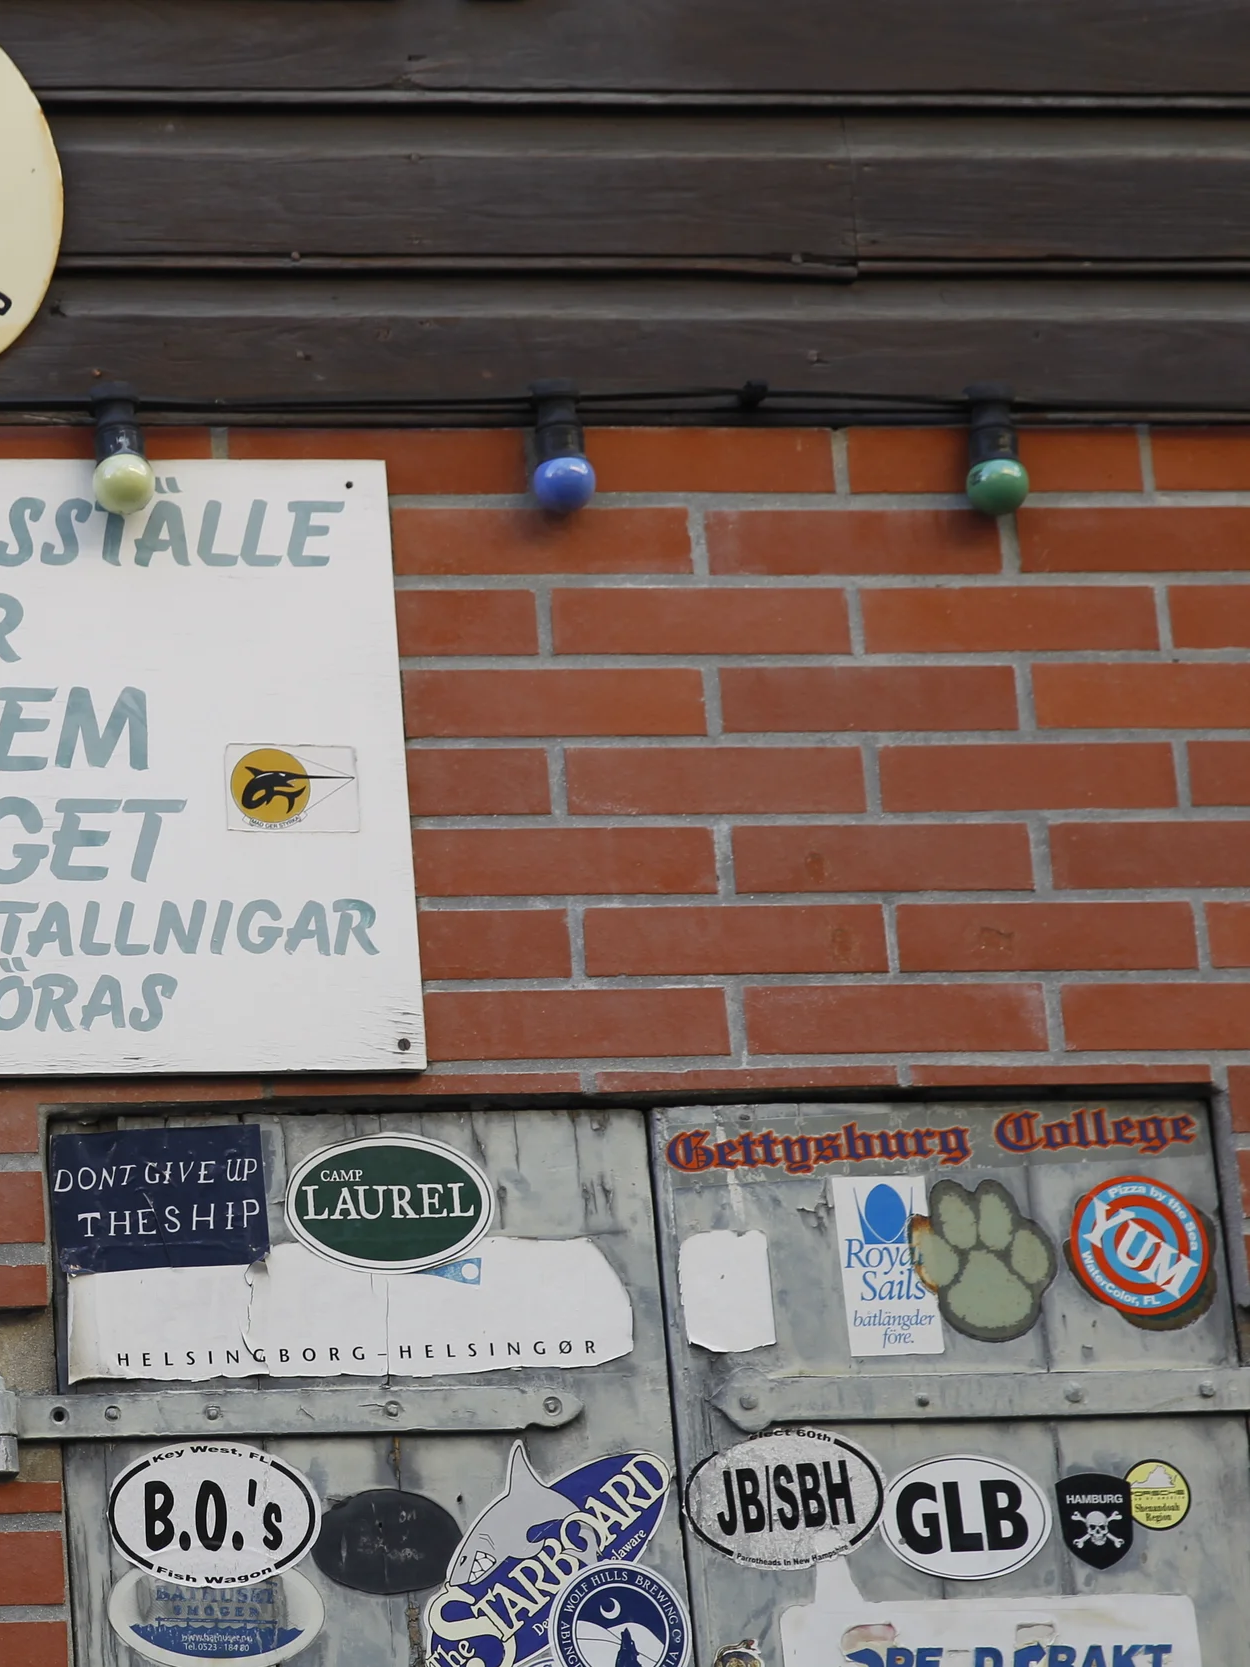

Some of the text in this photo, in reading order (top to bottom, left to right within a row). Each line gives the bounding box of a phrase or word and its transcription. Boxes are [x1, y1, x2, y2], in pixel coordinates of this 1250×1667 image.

[666, 1108, 1198, 1174] Gettysburg College
[54, 1158, 258, 1192] DONT GIVE UP
[320, 1169, 363, 1182] CAMP
[301, 1183, 474, 1221] LAUREL
[1107, 1185, 1198, 1251] Pizza by the Sea
[1082, 1197, 1199, 1299] YUM
[861, 1269, 926, 1301] Sails
[1143, 1295, 1161, 1305] FL
[797, 1429, 831, 1442] 60th
[152, 1446, 269, 1463] Key West, FL
[717, 1460, 856, 1536] JB/SBH
[1066, 1494, 1123, 1504] HAMBURG
[895, 1479, 1029, 1556] GLB
[736, 1552, 781, 1566] Parrotheads
[793, 1557, 810, 1565] New
[812, 1544, 849, 1562] Hampshire
[157, 1566, 272, 1584] Fish Wagon
[563, 1582, 589, 1614] WOLF
[590, 1571, 628, 1587] HILLS
[635, 1574, 679, 1625] BREWING
